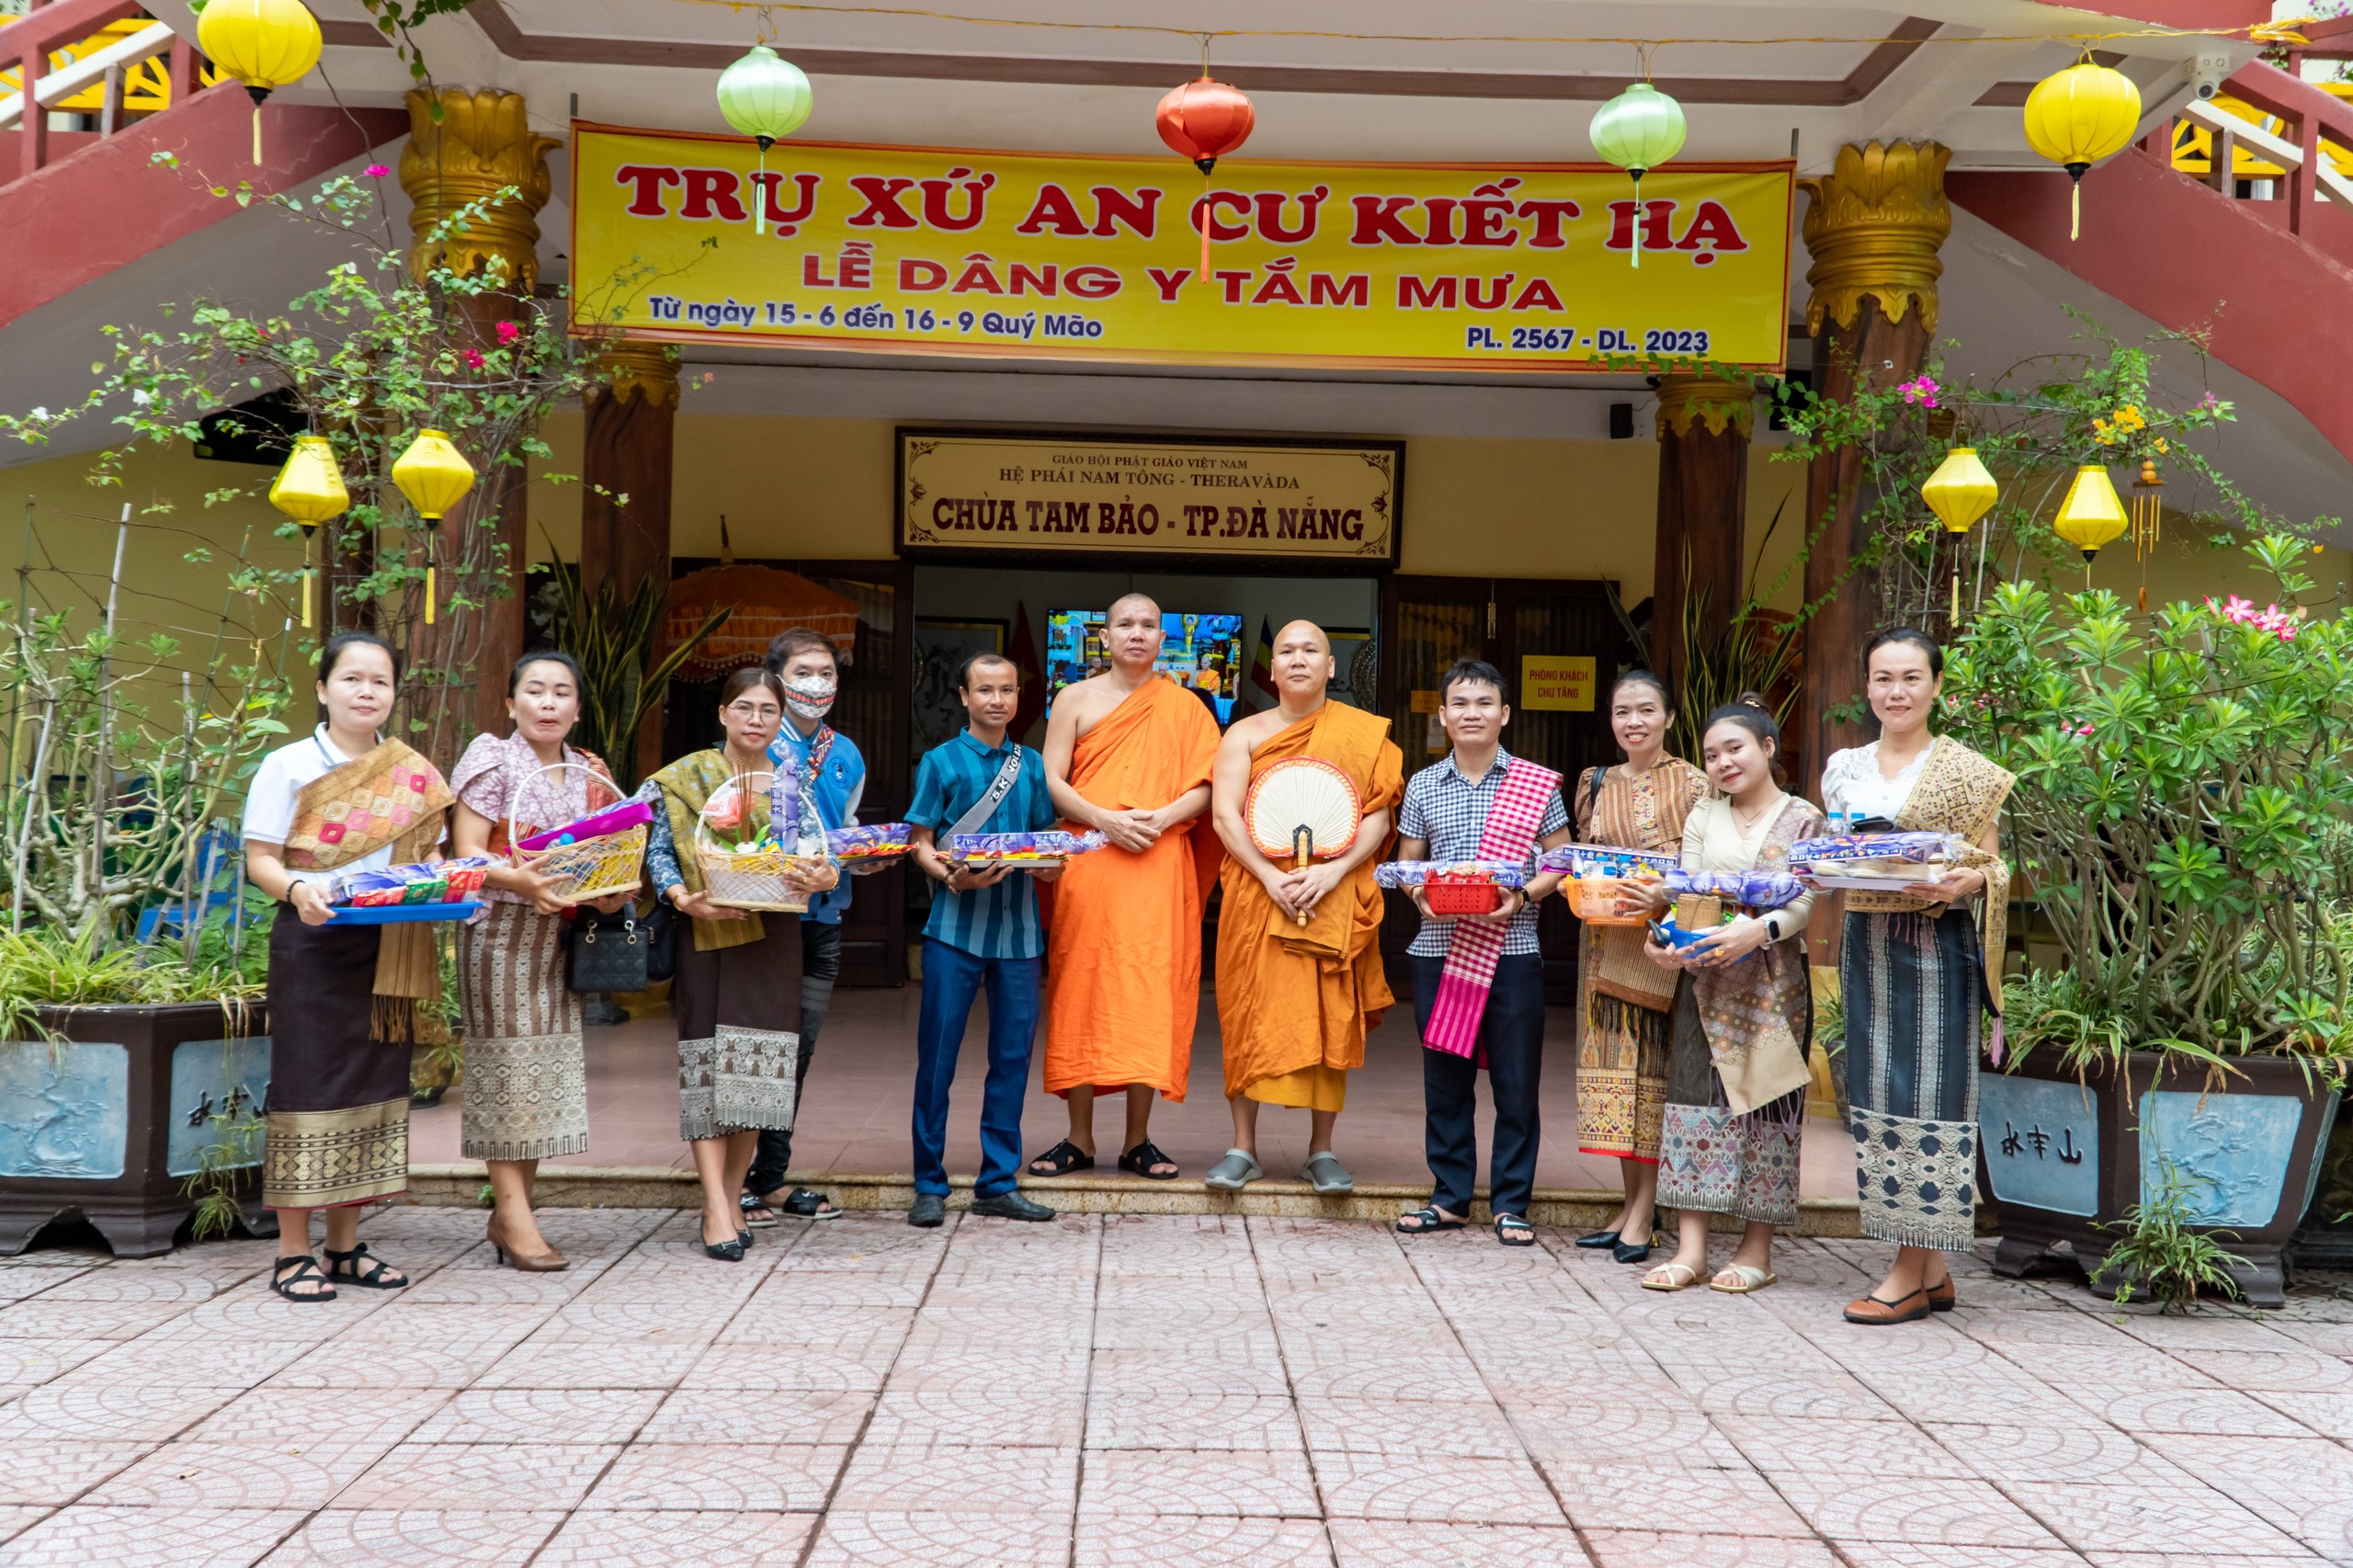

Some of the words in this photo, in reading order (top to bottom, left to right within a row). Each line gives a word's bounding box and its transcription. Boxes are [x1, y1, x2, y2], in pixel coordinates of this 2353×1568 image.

[618, 166, 820, 237] TRỤ
[848, 168, 995, 231] XỨ
[1017, 186, 1162, 238] AN
[1191, 186, 1329, 243] CƯ
[1351, 178, 1580, 248] KIẾT
[1607, 201, 1748, 265] HẠ
[804, 243, 872, 289] LỄ
[900, 254, 1121, 299] DÂNG
[1149, 268, 1191, 301] Y
[1215, 256, 1369, 306] TẮM
[1398, 274, 1564, 311] MƯA
[650, 296, 681, 319] Từ
[688, 300, 756, 326] ngày
[767, 303, 796, 324] 15
[820, 306, 835, 326] 6
[844, 302, 894, 328] đến
[905, 309, 935, 331] 16
[959, 312, 974, 332] 9
[983, 312, 1036, 339] Quý
[1044, 314, 1102, 337] Mão
[1467, 326, 1502, 347] PL.
[1512, 327, 1574, 349] 2567
[1597, 329, 1636, 351] DL.
[1646, 330, 1709, 352] 2023
[1052, 453, 1084, 465] GIÁO
[1087, 453, 1109, 467] HỘI
[1115, 455, 1149, 468] PHẬT
[1152, 456, 1184, 468] GIÁO
[1188, 457, 1217, 470] VIỆT
[1221, 460, 1247, 469] NAM
[999, 466, 1024, 484] HỆ
[1030, 467, 1074, 483] PHÁI
[1080, 471, 1120, 484] NAM
[1125, 470, 1175, 485] TÔNG
[1190, 472, 1300, 489] THERAVÀDA
[933, 491, 1018, 531] CHÙA
[1026, 501, 1090, 533] TAM
[1098, 494, 1159, 536] BẢO
[1184, 499, 1269, 539] TP.ĐÀ
[1277, 495, 1365, 541] NẴNG
[1529, 668, 1558, 681] PHÒNG
[1559, 669, 1588, 682] KHÁCH
[1538, 687, 1555, 699] CHƯ
[1557, 686, 1579, 699] TĂNG
